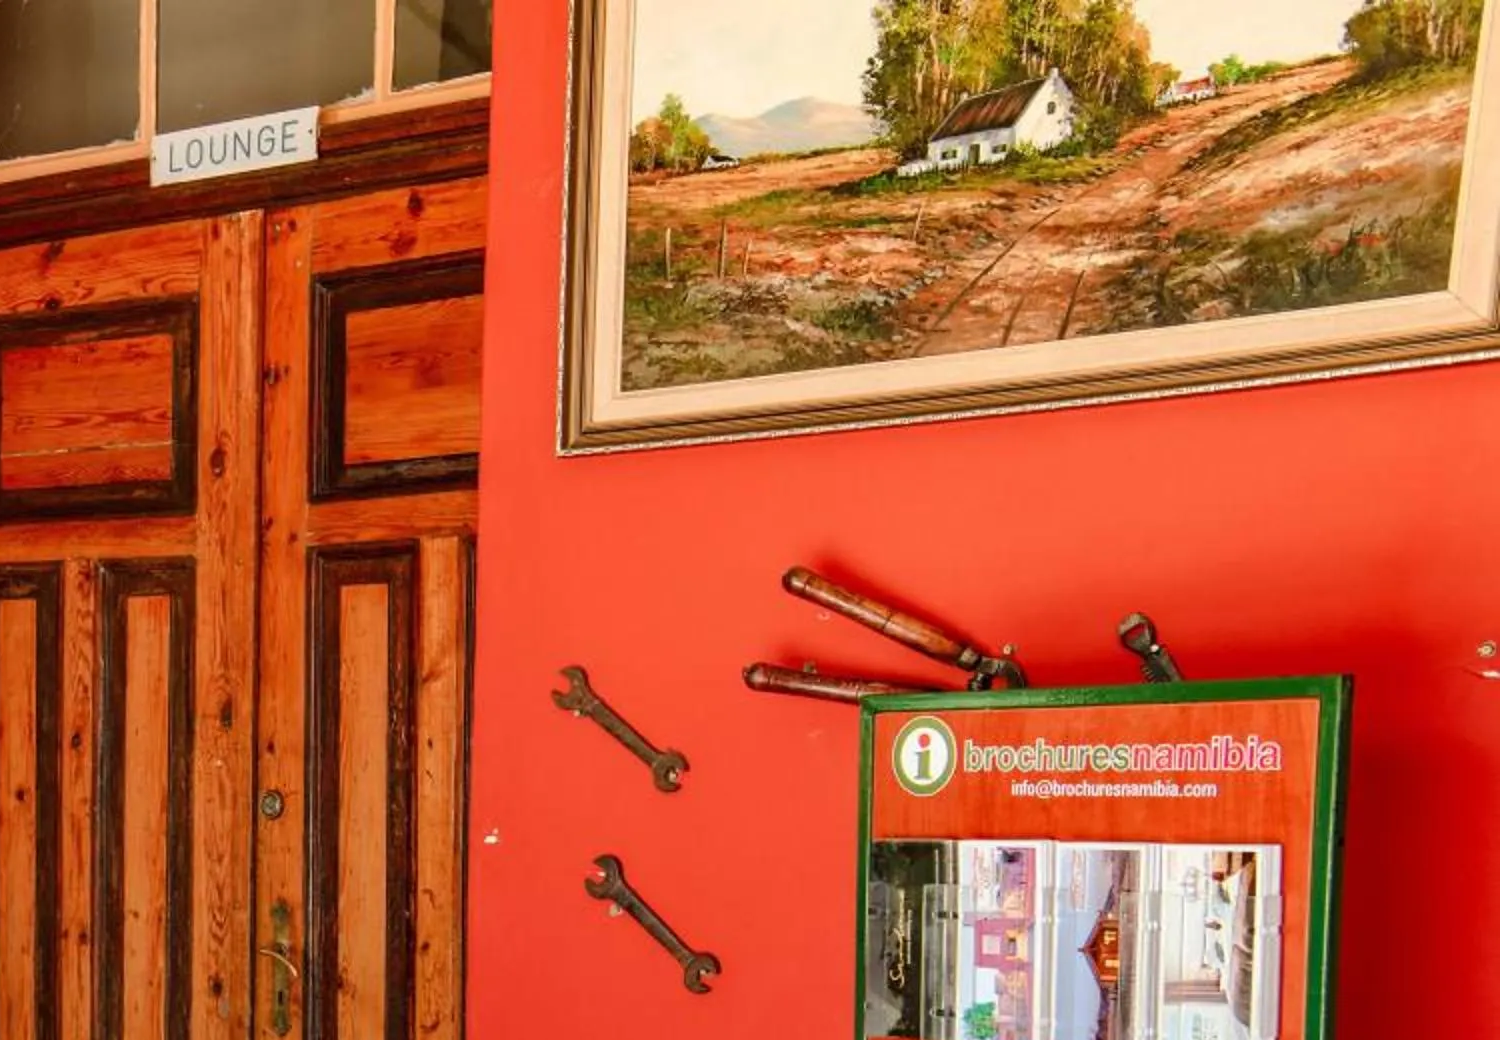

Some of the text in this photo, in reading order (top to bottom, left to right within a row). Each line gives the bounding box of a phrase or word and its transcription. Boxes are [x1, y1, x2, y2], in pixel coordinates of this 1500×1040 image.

[168, 120, 299, 173] LOUNGE
[963, 735, 1282, 772] brochuresnamibia
[1011, 779, 1217, 798] info@brochuresnamibia.com
